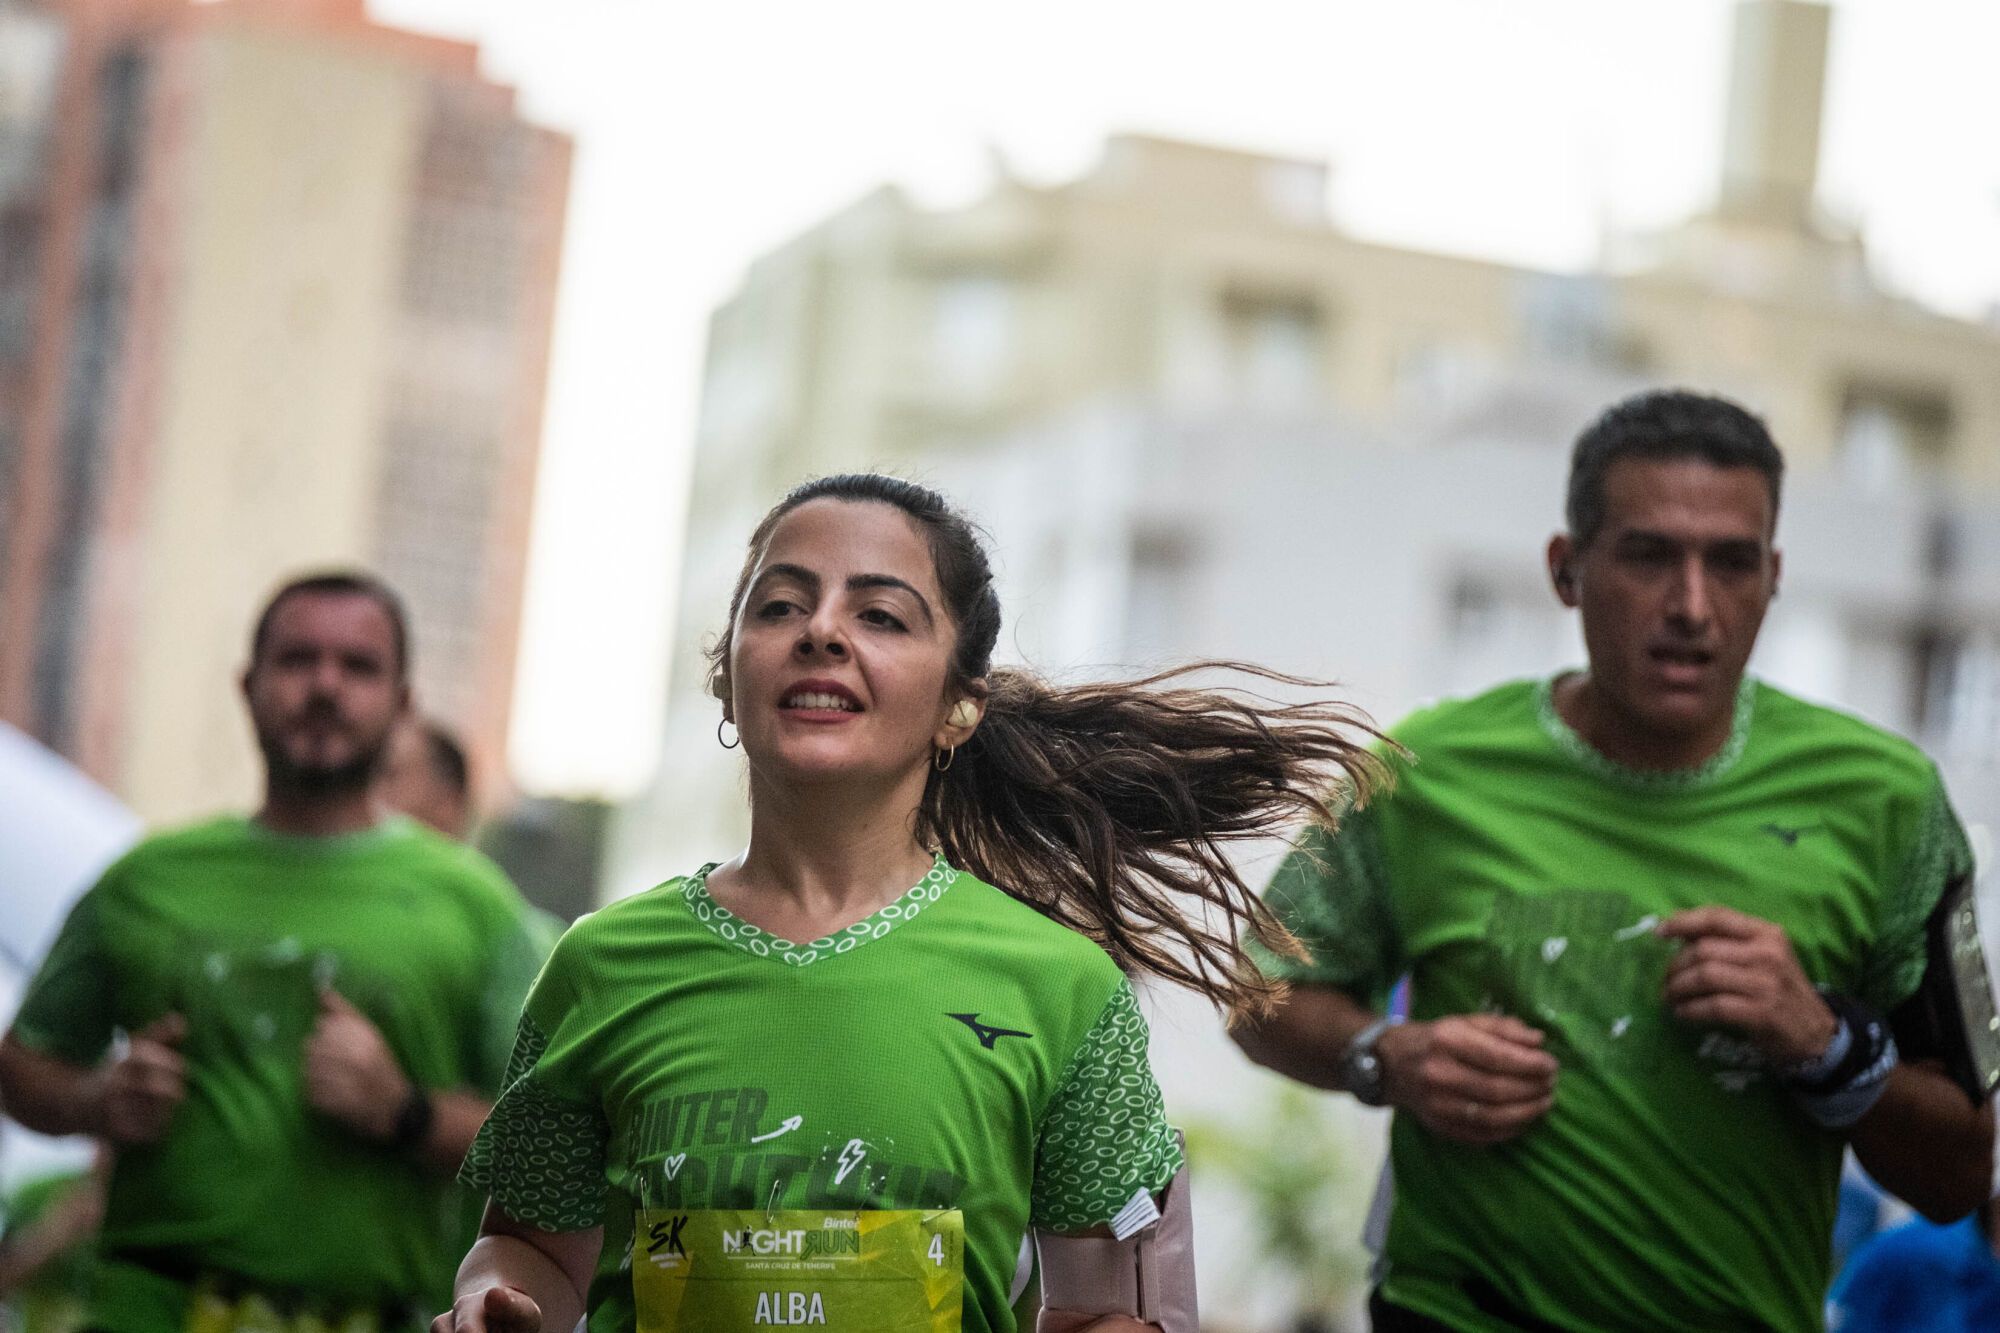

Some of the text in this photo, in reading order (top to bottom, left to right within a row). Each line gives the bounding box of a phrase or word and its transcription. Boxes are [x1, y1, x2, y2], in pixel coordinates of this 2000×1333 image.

[723, 1229, 860, 1260] NGHTRUN
[927, 1232, 945, 1267] 4
[745, 1262, 836, 1270] SANTA CRUZ DE TENERIFE
[754, 1291, 827, 1325] ALBA
